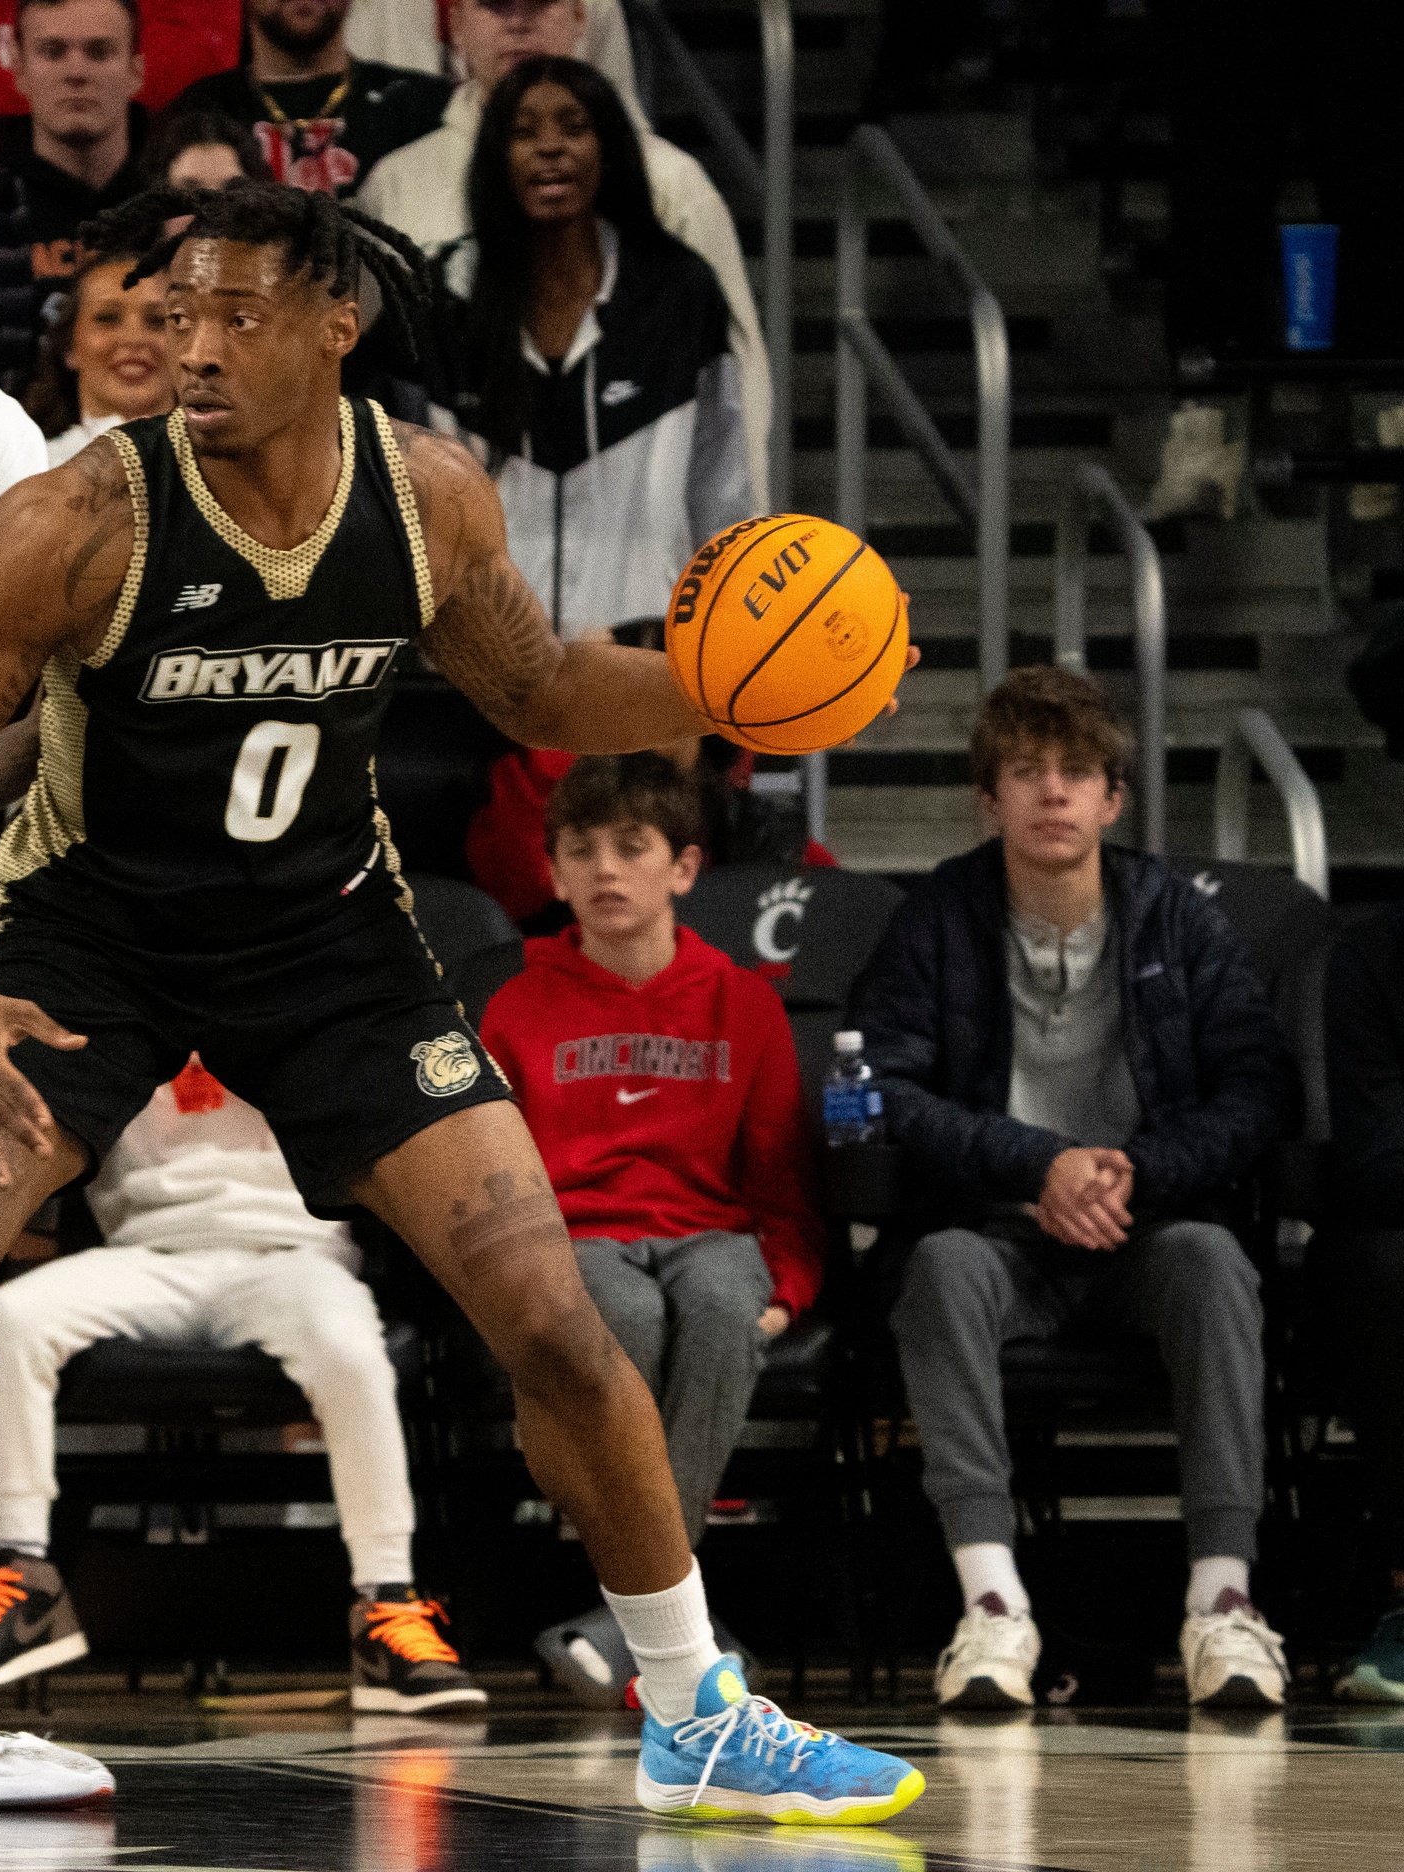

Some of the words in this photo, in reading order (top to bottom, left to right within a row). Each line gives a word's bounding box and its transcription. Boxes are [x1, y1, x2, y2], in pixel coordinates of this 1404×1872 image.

[743, 540, 812, 621] EVO
[147, 646, 392, 699] BRYANT
[224, 719, 322, 843] 0
